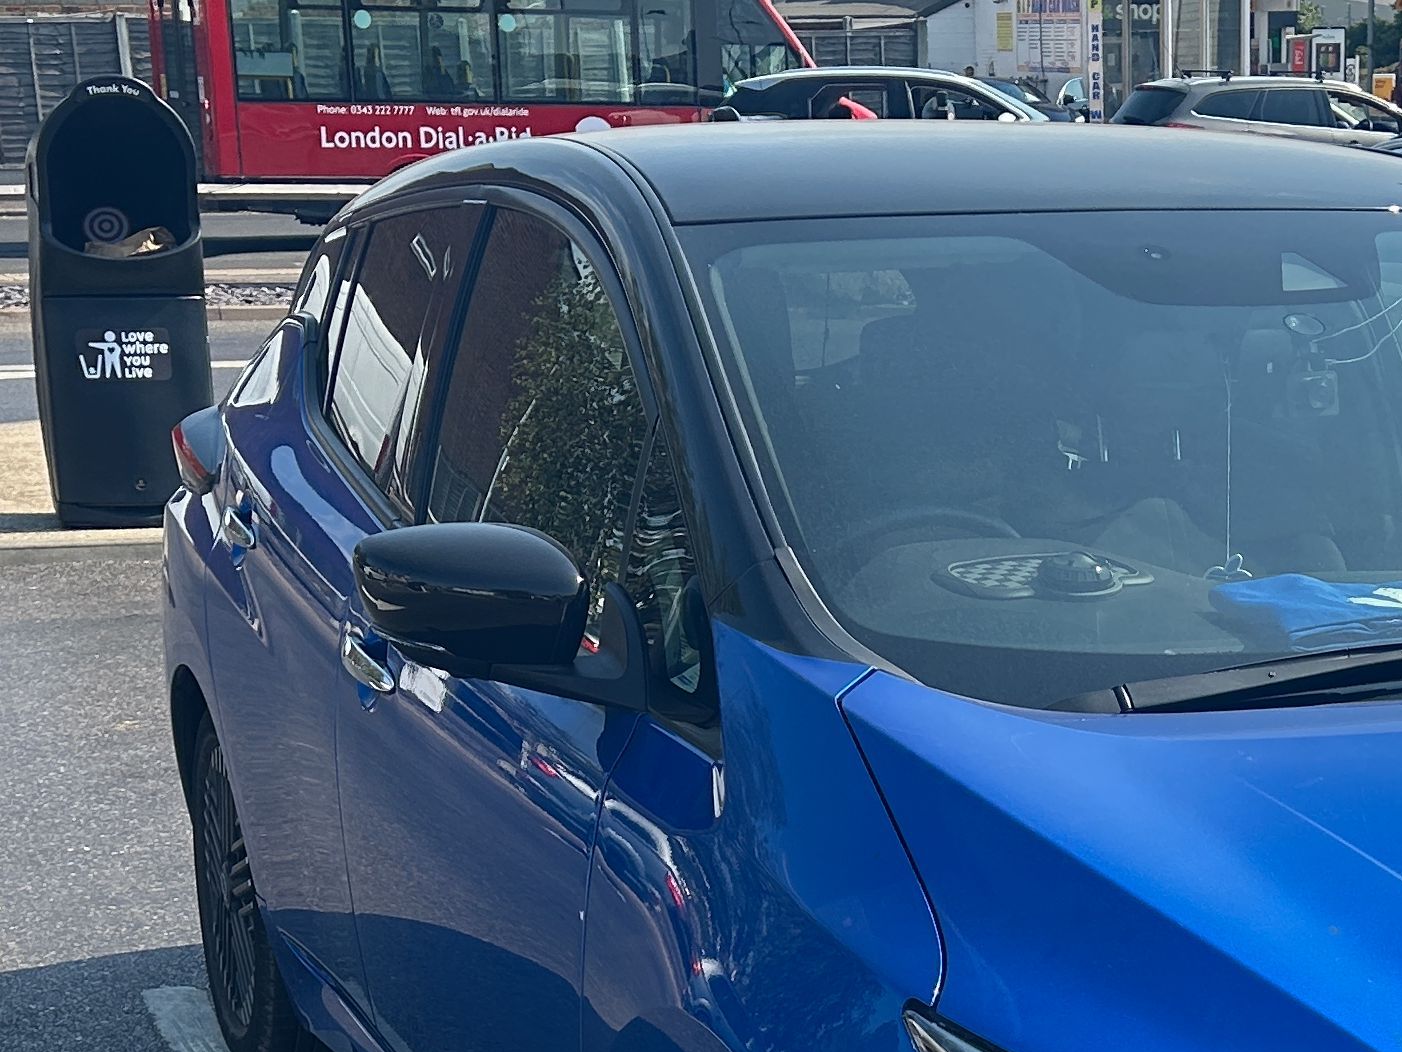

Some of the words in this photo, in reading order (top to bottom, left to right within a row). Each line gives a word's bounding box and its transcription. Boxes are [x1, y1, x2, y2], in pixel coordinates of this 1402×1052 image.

[86, 84, 120, 95] Thank
[121, 84, 140, 96] You
[350, 105, 373, 115] 0343
[374, 105, 392, 115] 222
[392, 105, 415, 115] 7777
[320, 126, 413, 149] London
[121, 331, 154, 342] Love
[122, 341, 168, 354] where
[125, 367, 153, 378] Live
